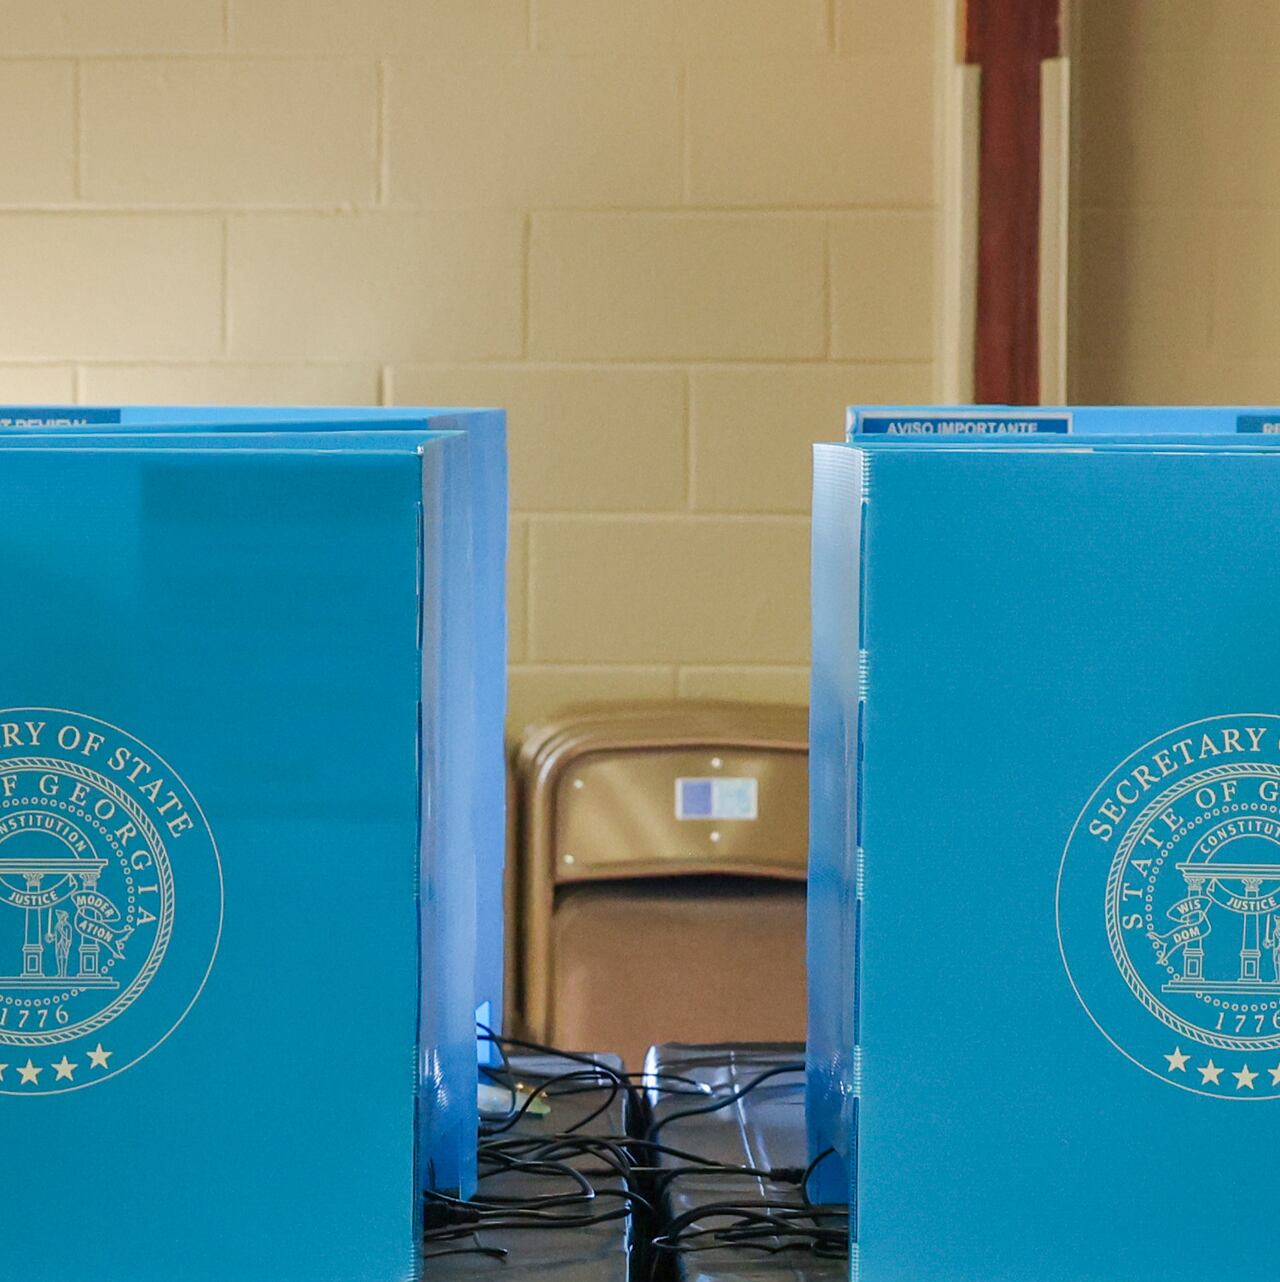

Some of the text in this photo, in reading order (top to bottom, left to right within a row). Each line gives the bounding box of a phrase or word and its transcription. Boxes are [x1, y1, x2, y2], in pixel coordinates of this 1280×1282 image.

[886, 422, 1038, 434] AVISO IMPORTANTE
[57, 725, 105, 756] OF
[107, 746, 194, 838] STATE
[1089, 728, 1267, 843] SECRETARY
[39, 774, 158, 927] GEORGIA
[1122, 807, 1184, 929] STATE
[1195, 781, 1238, 810] OF
[9, 891, 59, 905] JUSTICE
[76, 895, 114, 918] MODER
[1177, 899, 1201, 915] WIS
[1226, 897, 1277, 911] JUSTICE
[79, 920, 113, 943] ATION
[1173, 927, 1200, 944] DOM
